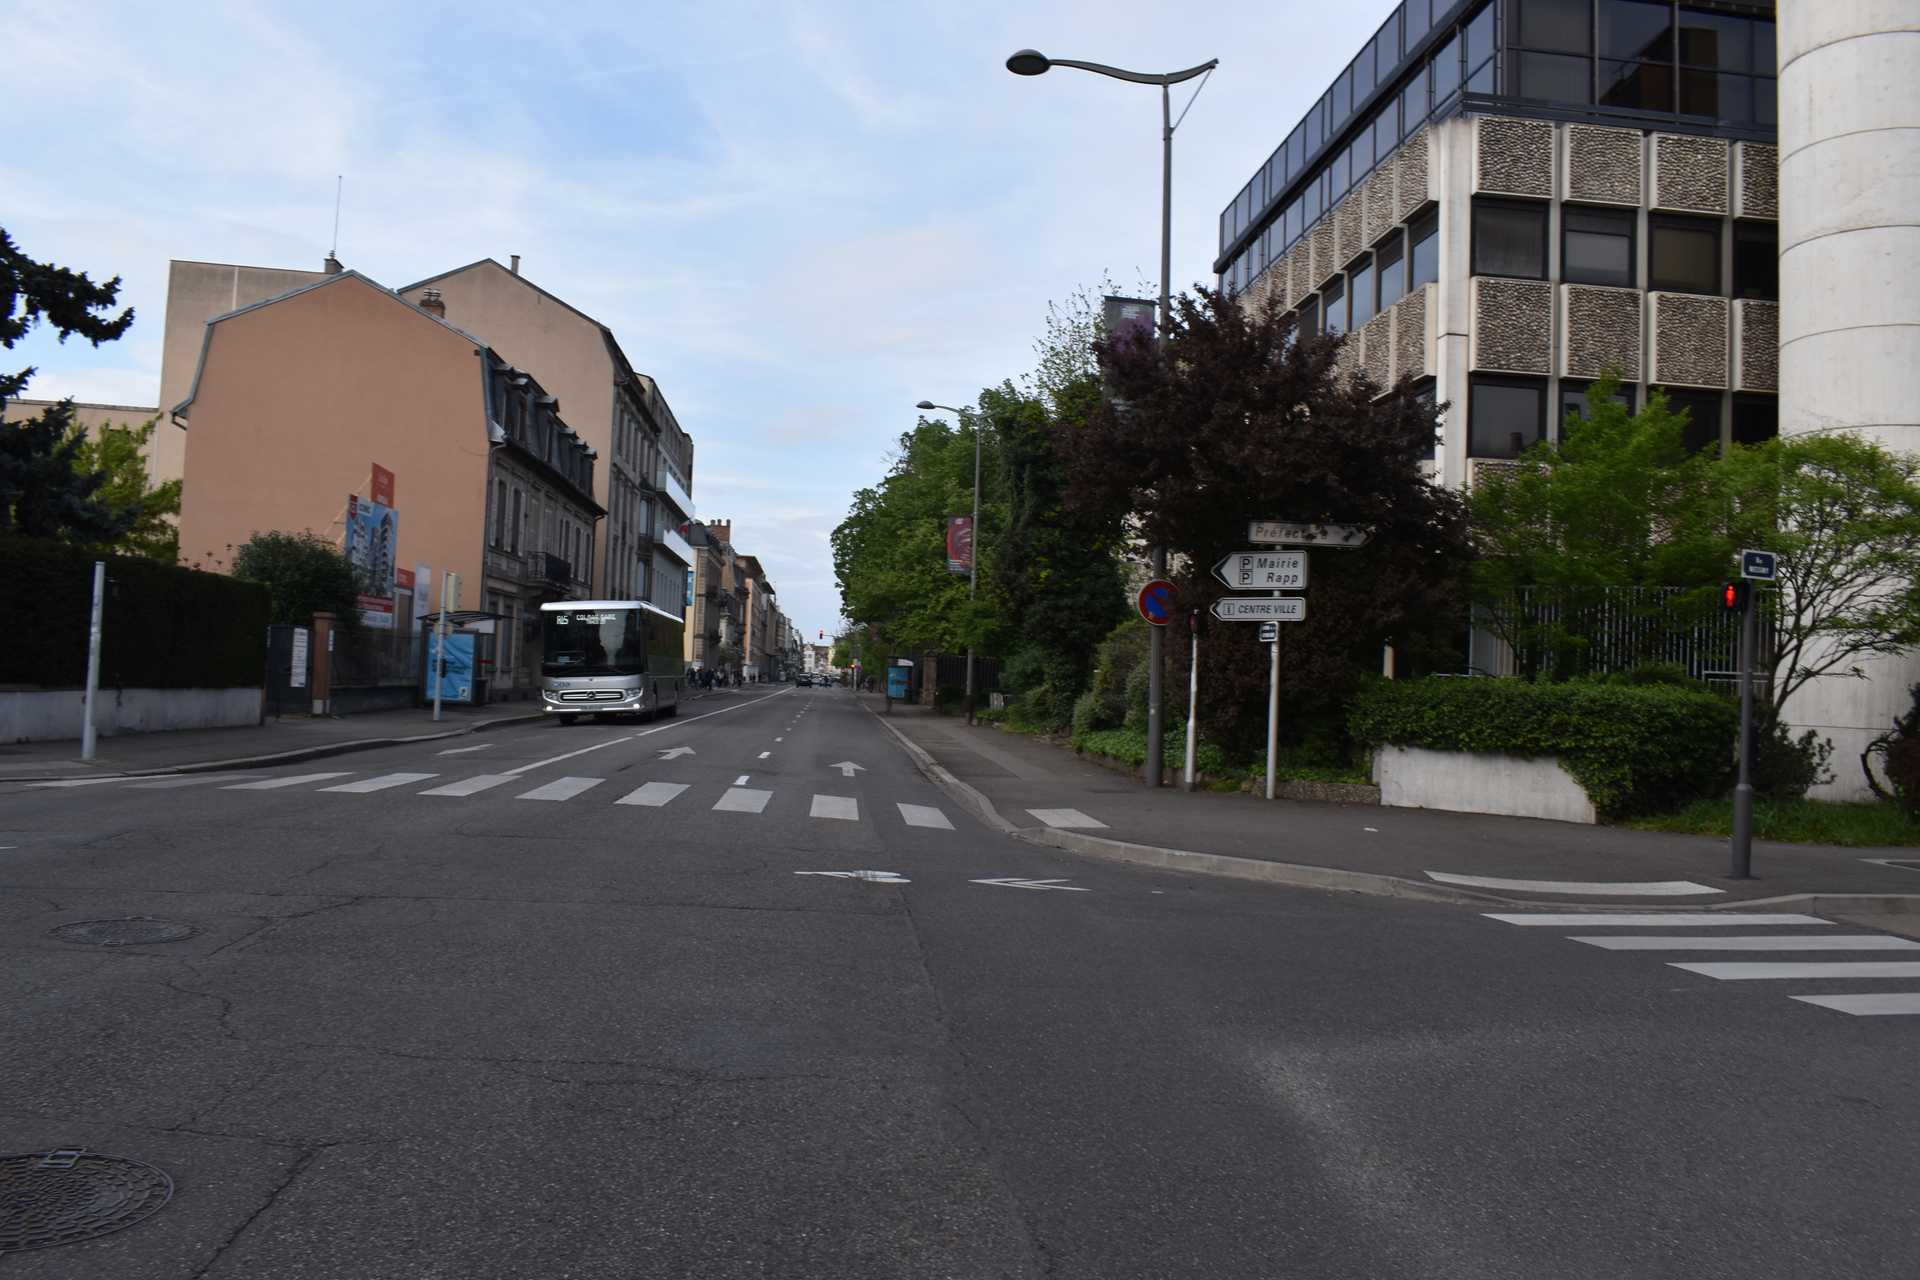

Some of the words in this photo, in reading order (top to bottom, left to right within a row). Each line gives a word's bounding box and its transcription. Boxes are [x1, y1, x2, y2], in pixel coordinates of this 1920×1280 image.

[1242, 558, 1250, 569] P
[1256, 557, 1299, 569] Mairie
[1242, 573, 1250, 583] P
[1266, 572, 1299, 585] Rapp
[1238, 605, 1272, 614] CENTRE
[1274, 605, 1297, 614] VILLE
